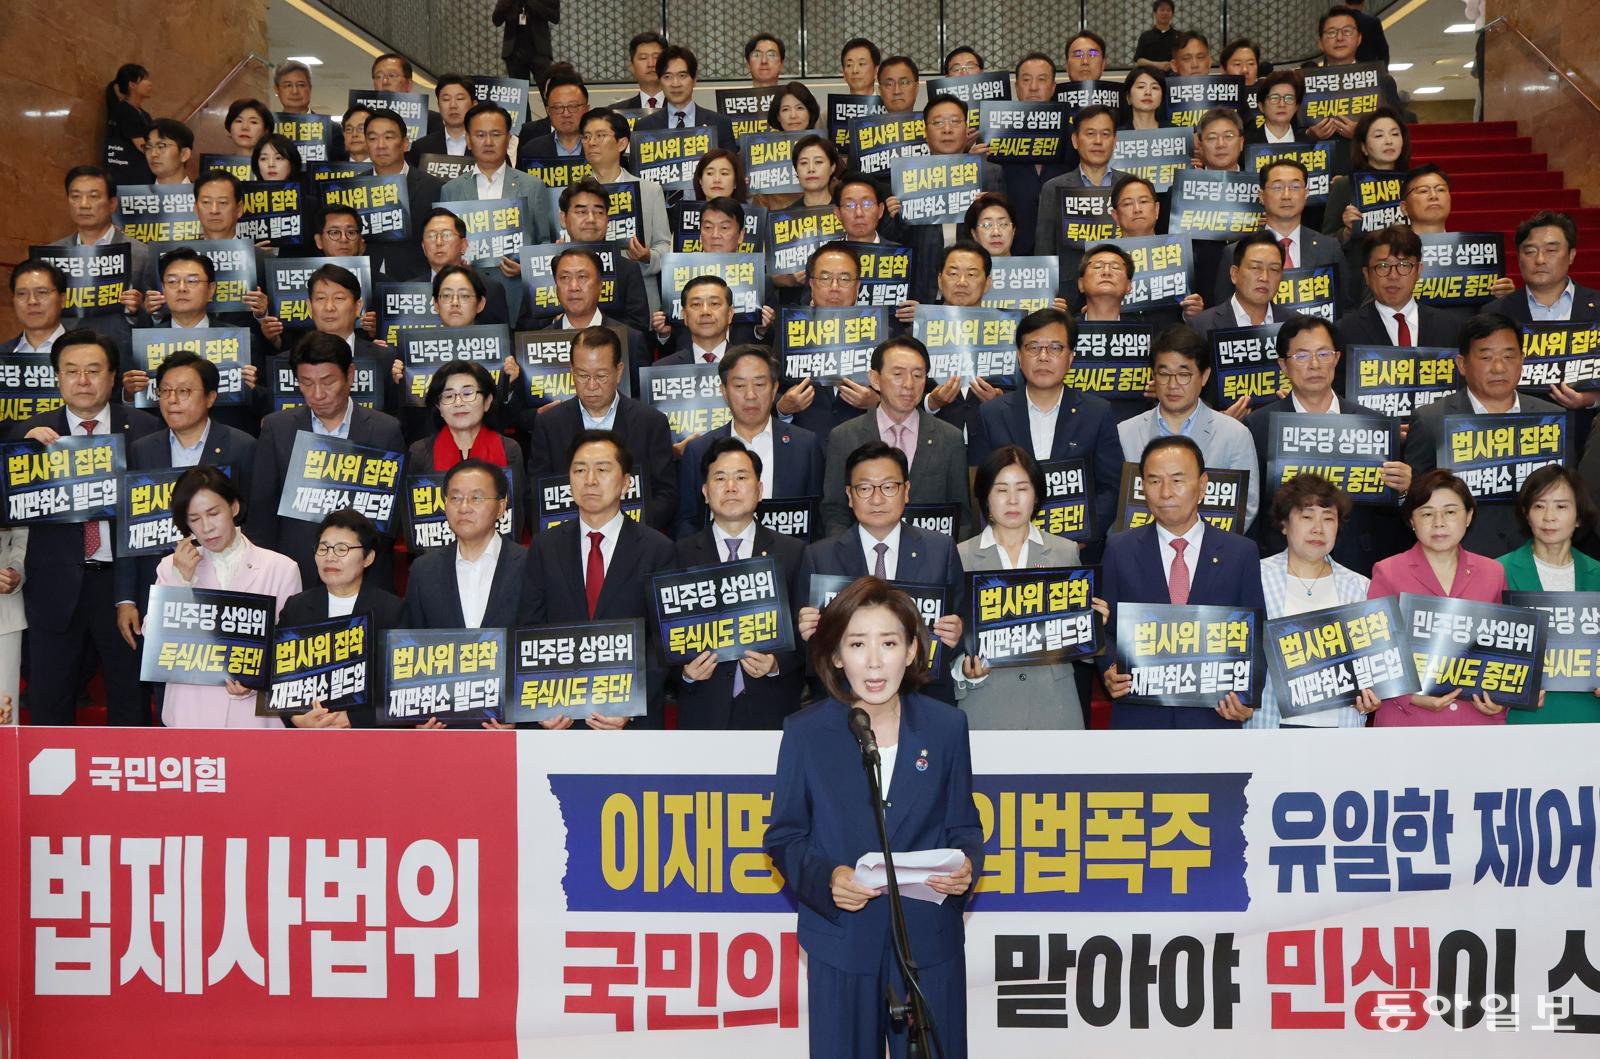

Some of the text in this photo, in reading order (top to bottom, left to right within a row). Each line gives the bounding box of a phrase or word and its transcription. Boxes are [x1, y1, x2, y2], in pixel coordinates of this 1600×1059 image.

[490, 85, 522, 104] 상임위
[972, 81, 1004, 100] 상임위
[1170, 84, 1239, 102] 민주당 상임위
[1305, 70, 1377, 93] 민주당 상임위
[725, 96, 758, 114] 민주당
[836, 103, 868, 120] 민주당
[1091, 90, 1119, 108] 상임위
[1307, 95, 1377, 118] 독식시도 중단!
[300, 121, 323, 141] 집착
[989, 110, 1024, 129] 민주당
[1027, 111, 1062, 129] 상임위
[640, 134, 709, 163] 법사위 집착
[859, 123, 899, 149] 법사위
[989, 138, 1058, 156] 독식시도 중단!
[1113, 138, 1187, 159] 민주당 상임위
[751, 140, 790, 165] 법사위
[1301, 151, 1327, 171] 집착
[640, 161, 679, 184] 재판취소
[750, 168, 790, 189] 재판취소
[903, 162, 979, 193] 법사위 집착
[271, 190, 298, 211] 집착
[371, 184, 398, 206] 집착
[1183, 181, 1223, 200] 민주당
[121, 194, 160, 214] 민주당
[902, 195, 946, 220] 재판취소
[1066, 197, 1104, 215] 민주당
[173, 221, 200, 241] 중단!
[270, 216, 300, 238] 빌드업
[371, 209, 402, 235] 빌드업
[492, 208, 520, 229] 집착
[775, 216, 817, 244] 법사위
[1180, 211, 1260, 232] 독식시도 중단!
[491, 232, 523, 259] 빌드업
[1151, 244, 1182, 270] 집착
[1456, 243, 1498, 266] 상임위
[88, 254, 124, 277] 상임위
[725, 263, 754, 286] 집착
[878, 255, 909, 279] 집착
[1010, 268, 1050, 288] 상임위
[873, 284, 908, 305] 빌드업
[1150, 272, 1186, 299] 빌드업
[1298, 275, 1330, 302] 집착
[386, 294, 426, 315] 민주당
[788, 317, 877, 347] 법사위 집착
[927, 319, 1017, 347] 법사위 집착
[205, 338, 238, 362] 집착
[409, 337, 500, 363] 민주당 상임위
[527, 341, 571, 364] 민주당
[1110, 334, 1151, 357] 상임위
[1219, 338, 1262, 364] 민주당
[786, 352, 837, 379] 재판취소
[977, 351, 1016, 377] 빌드업
[1359, 358, 1455, 388] 법사위 집착
[652, 376, 696, 400] 민주당
[1118, 368, 1152, 391] 중단!
[1223, 371, 1275, 399] 독식시도
[1282, 427, 1389, 455] 민주당 상임위
[1452, 424, 1560, 463] 법사위 집착
[8, 446, 113, 485] 법사위 집착
[303, 450, 398, 487] 법사위 집착
[1347, 466, 1385, 493] 중단!
[8, 479, 117, 520] 재판취소 빌드업
[353, 491, 394, 521] 빌드업
[761, 510, 808, 535] 상임위
[1049, 505, 1084, 534] 중단!
[660, 570, 775, 614] 민주당 상임위
[979, 582, 1043, 622] 법사위
[1048, 578, 1089, 613] 집착
[163, 601, 267, 637] 민주당 상임위
[1412, 610, 1472, 645] 민주당
[1477, 617, 1535, 653] 상임위
[669, 610, 777, 655] 독식시도 중단!
[978, 615, 1092, 660] 재판취소 빌드업
[1134, 621, 1249, 656] 법사위 집착
[1279, 610, 1392, 670] 법사위 집착
[157, 643, 263, 676] 독식시도 중단!
[276, 625, 365, 675] 법사위 집착
[393, 640, 498, 681] 법사위 집착
[520, 633, 633, 667] 민주당 상임위
[269, 661, 366, 709] 재판취소 빌드업
[1130, 660, 1250, 696] 재판취소 빌드업
[1287, 646, 1405, 708] 재판취소 빌드업
[1481, 660, 1530, 694] 중단!
[388, 677, 500, 718] 재판취소 빌드업
[520, 673, 633, 710] 독식시도 중단!
[89, 755, 226, 793] 국민의힘
[601, 791, 785, 894] 이재명
[1269, 787, 1454, 893] 유일한
[1473, 785, 1600, 888] 제어
[30, 835, 480, 999] 법제사법위
[563, 931, 799, 1032] 국민의
[994, 932, 1241, 1030] 맡아야
[1266, 927, 1517, 1030] 민생이
